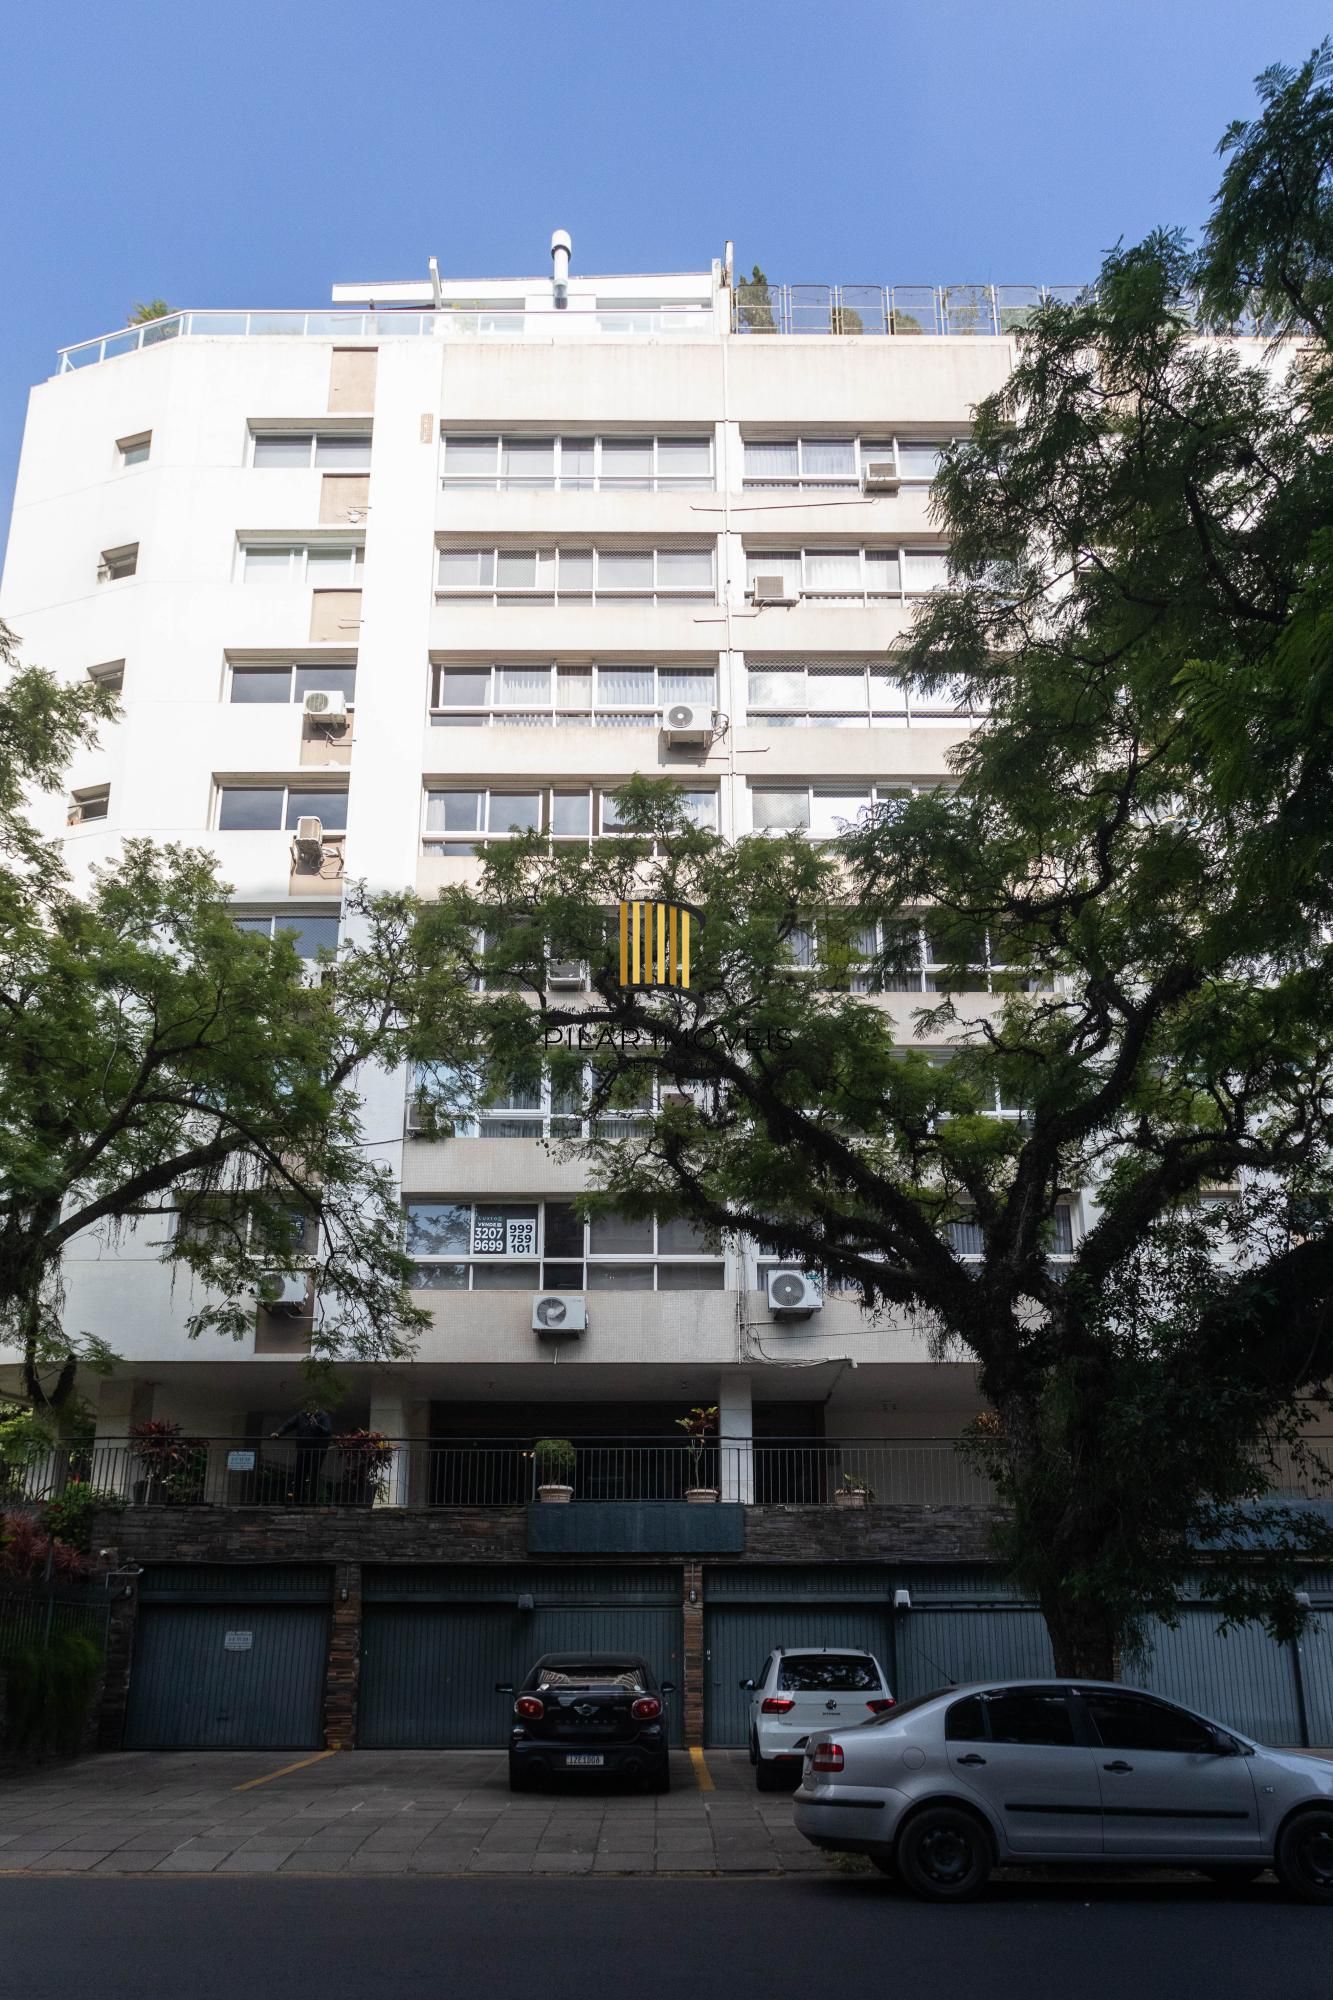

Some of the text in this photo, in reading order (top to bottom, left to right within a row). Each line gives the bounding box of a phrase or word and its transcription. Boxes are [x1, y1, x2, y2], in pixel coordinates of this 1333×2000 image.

[475, 1228, 503, 1239] 3207
[509, 1224, 533, 1234] 999
[510, 1234, 532, 1244] 759
[474, 1240, 503, 1251] 9699
[511, 1244, 531, 1253] 101
